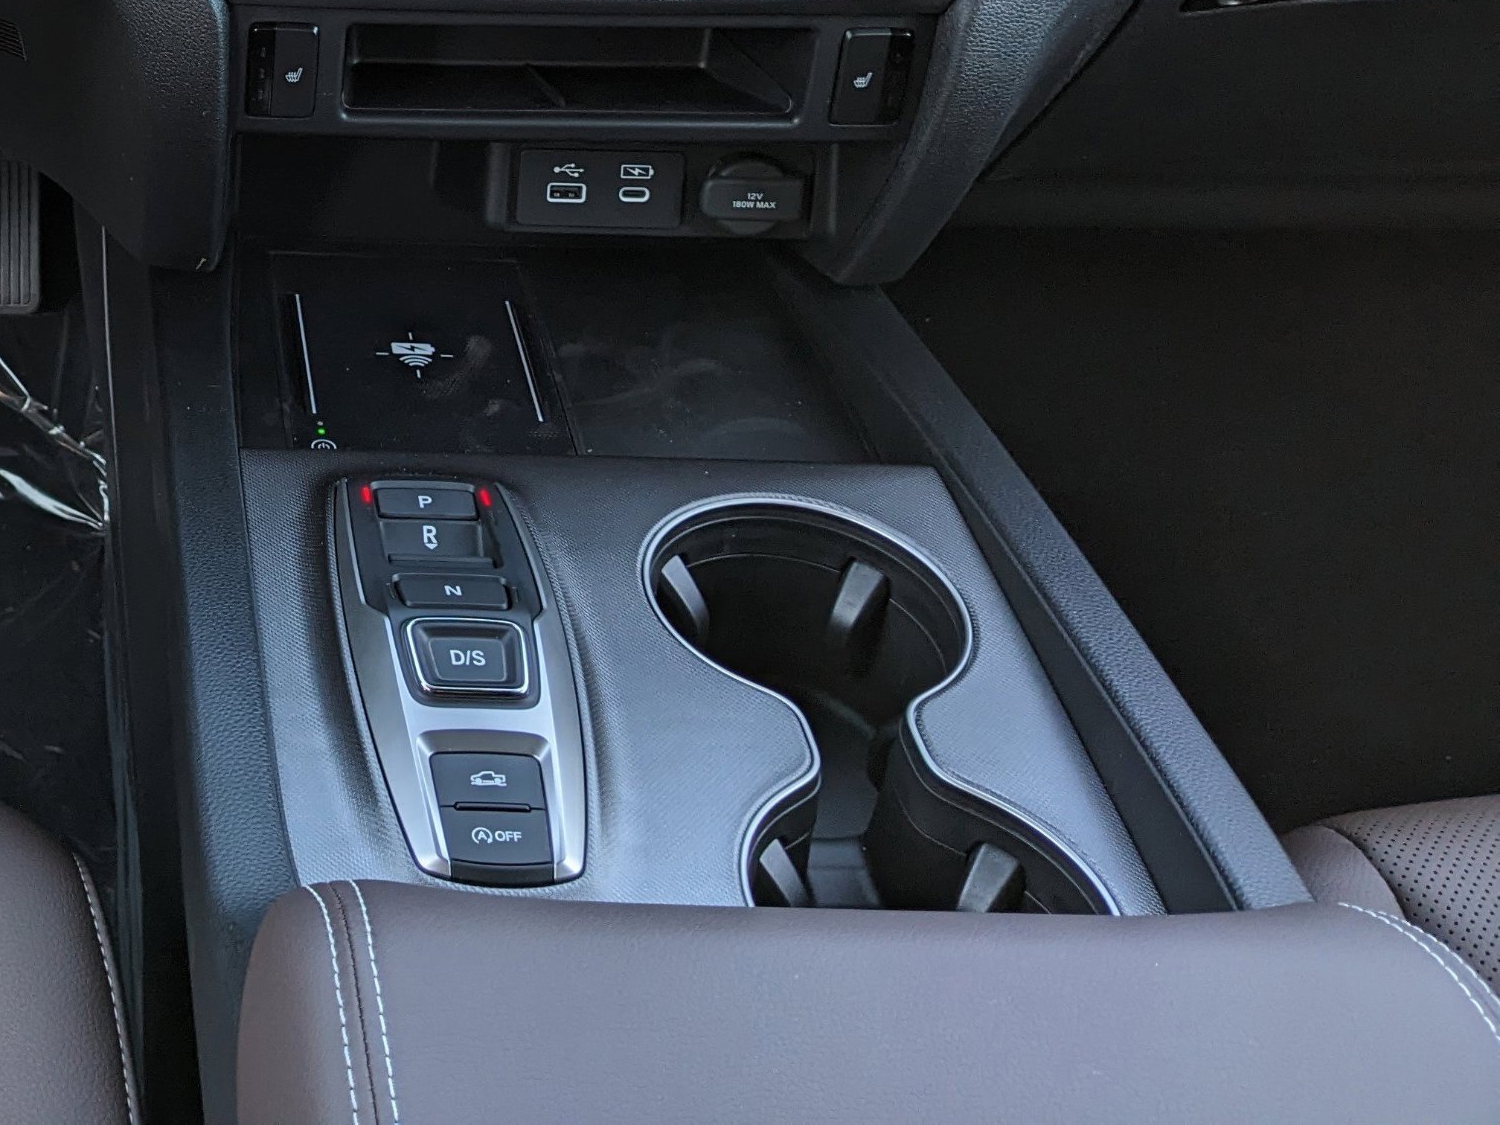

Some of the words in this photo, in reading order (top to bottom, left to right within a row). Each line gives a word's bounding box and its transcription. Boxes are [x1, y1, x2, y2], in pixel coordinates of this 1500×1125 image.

[732, 201, 755, 209] 180W
[756, 201, 776, 209] MAX
[418, 495, 433, 508] P
[422, 525, 438, 544] R
[443, 585, 462, 596] N
[450, 650, 486, 666] D/S
[494, 830, 522, 842] OFF
